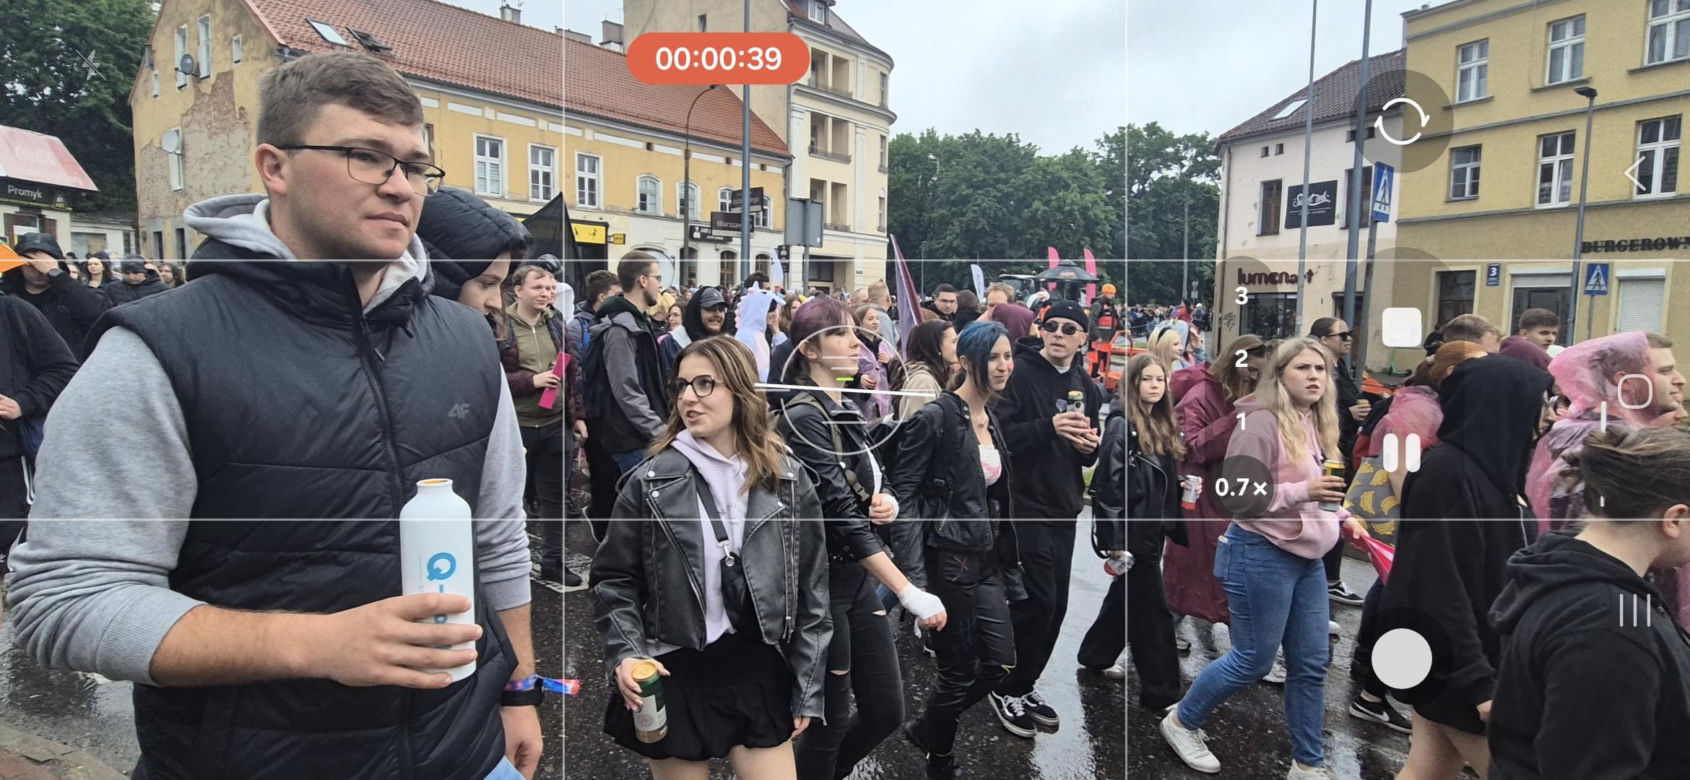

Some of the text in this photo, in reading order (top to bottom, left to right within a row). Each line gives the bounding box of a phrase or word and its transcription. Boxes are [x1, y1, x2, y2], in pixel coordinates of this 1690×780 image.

[8, 185, 42, 200] Promyk
[1237, 267, 1314, 285] lumenat
[1489, 266, 1497, 276] 3
